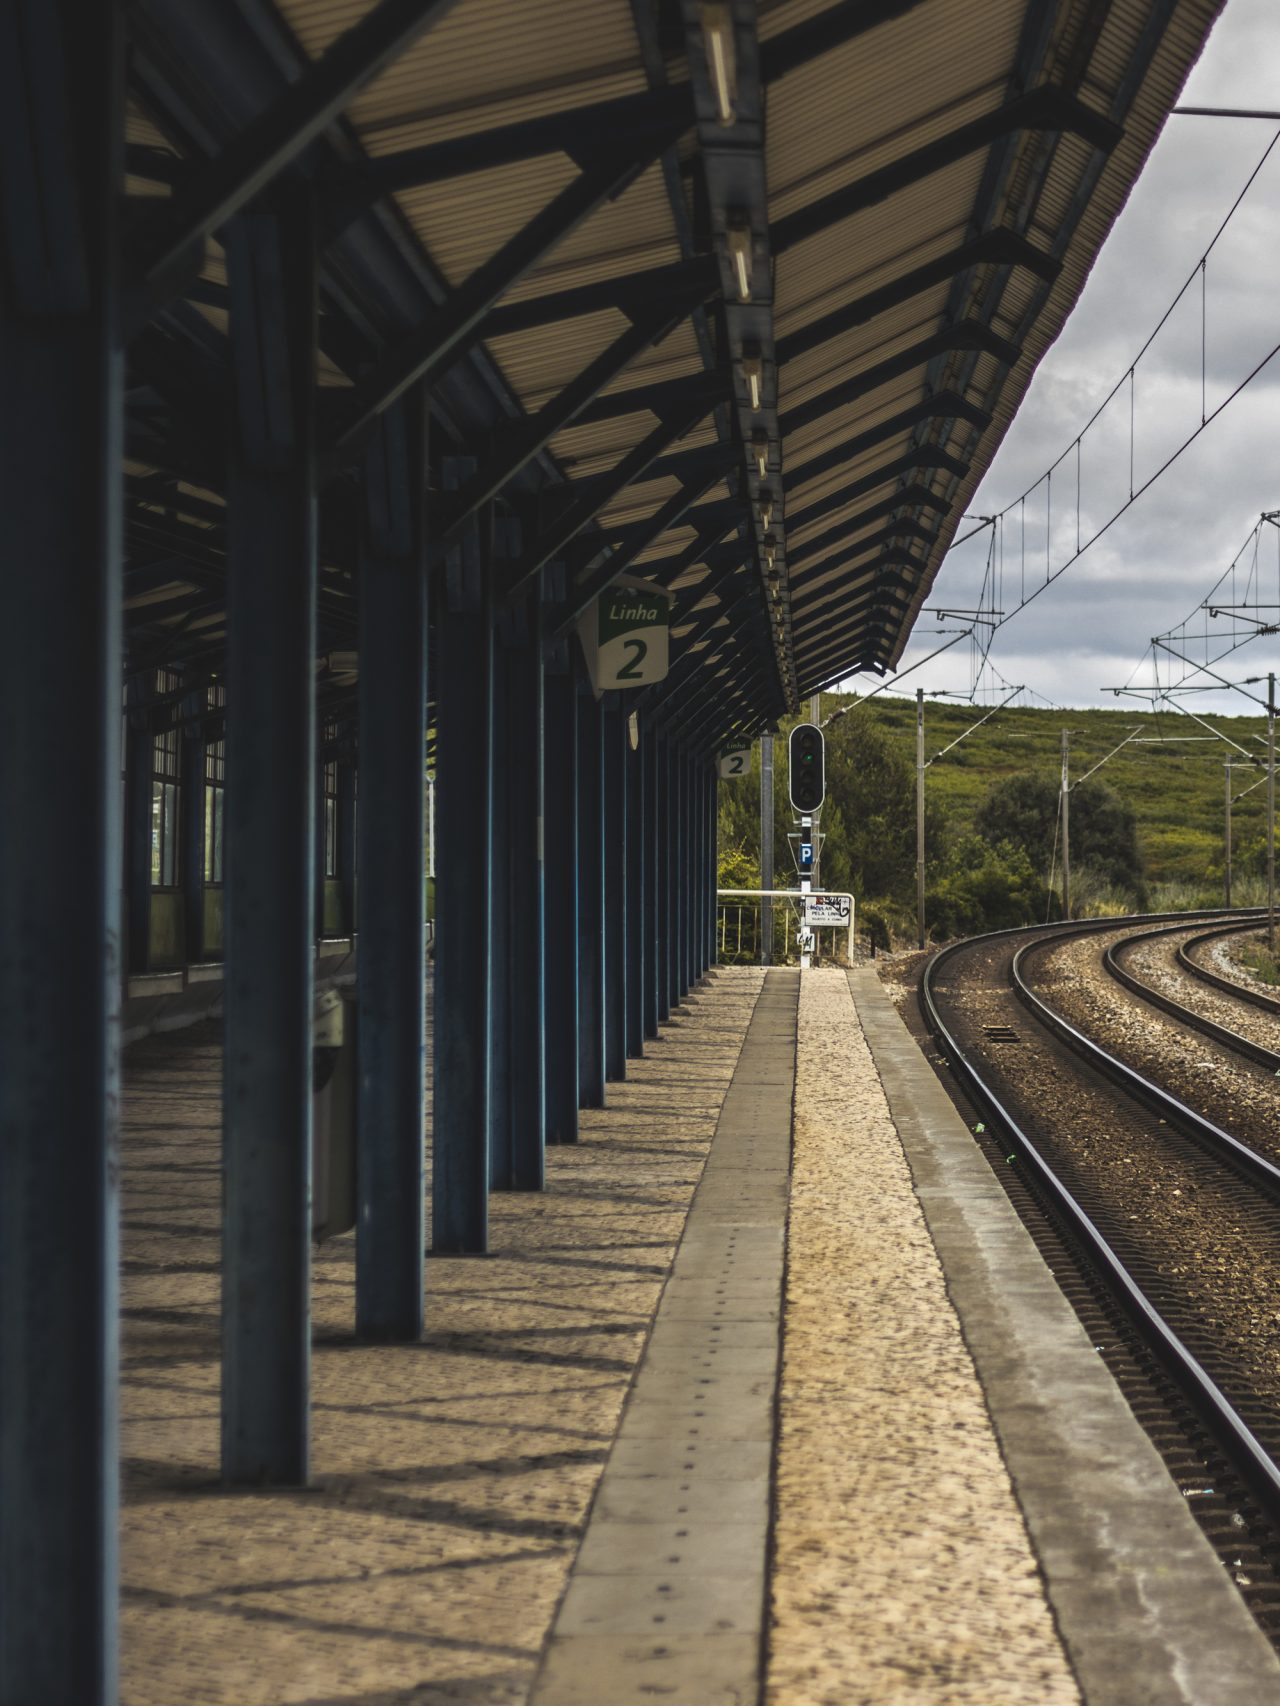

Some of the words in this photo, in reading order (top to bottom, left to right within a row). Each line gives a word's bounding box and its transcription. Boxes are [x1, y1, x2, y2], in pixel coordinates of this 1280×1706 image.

[609, 604, 658, 621] Linha
[616, 639, 647, 680] 2
[729, 756, 743, 774] 2
[802, 847, 811, 863] P
